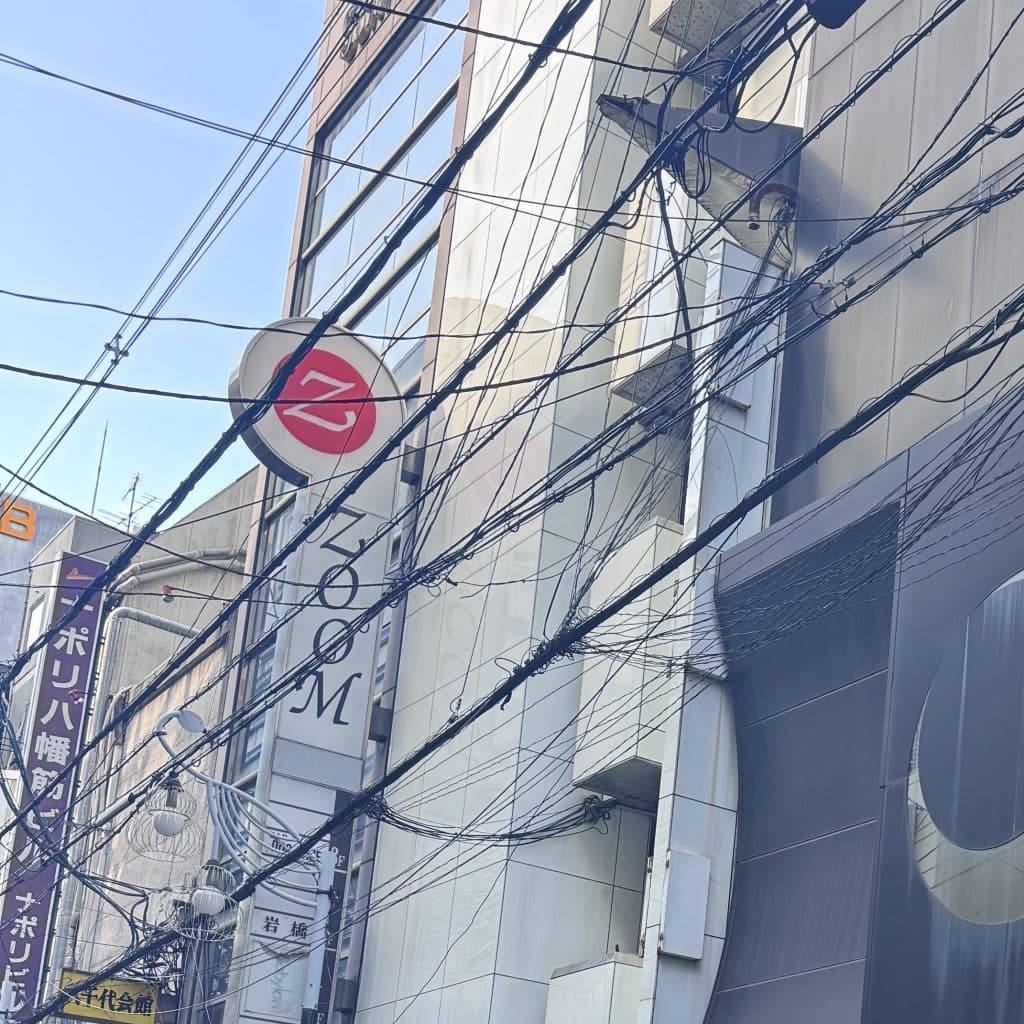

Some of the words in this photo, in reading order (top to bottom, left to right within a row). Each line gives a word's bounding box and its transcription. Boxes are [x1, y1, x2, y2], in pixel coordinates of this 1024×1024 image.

[289, 505, 367, 725] ZOOM
[69, 986, 154, 1016] 千代会館
